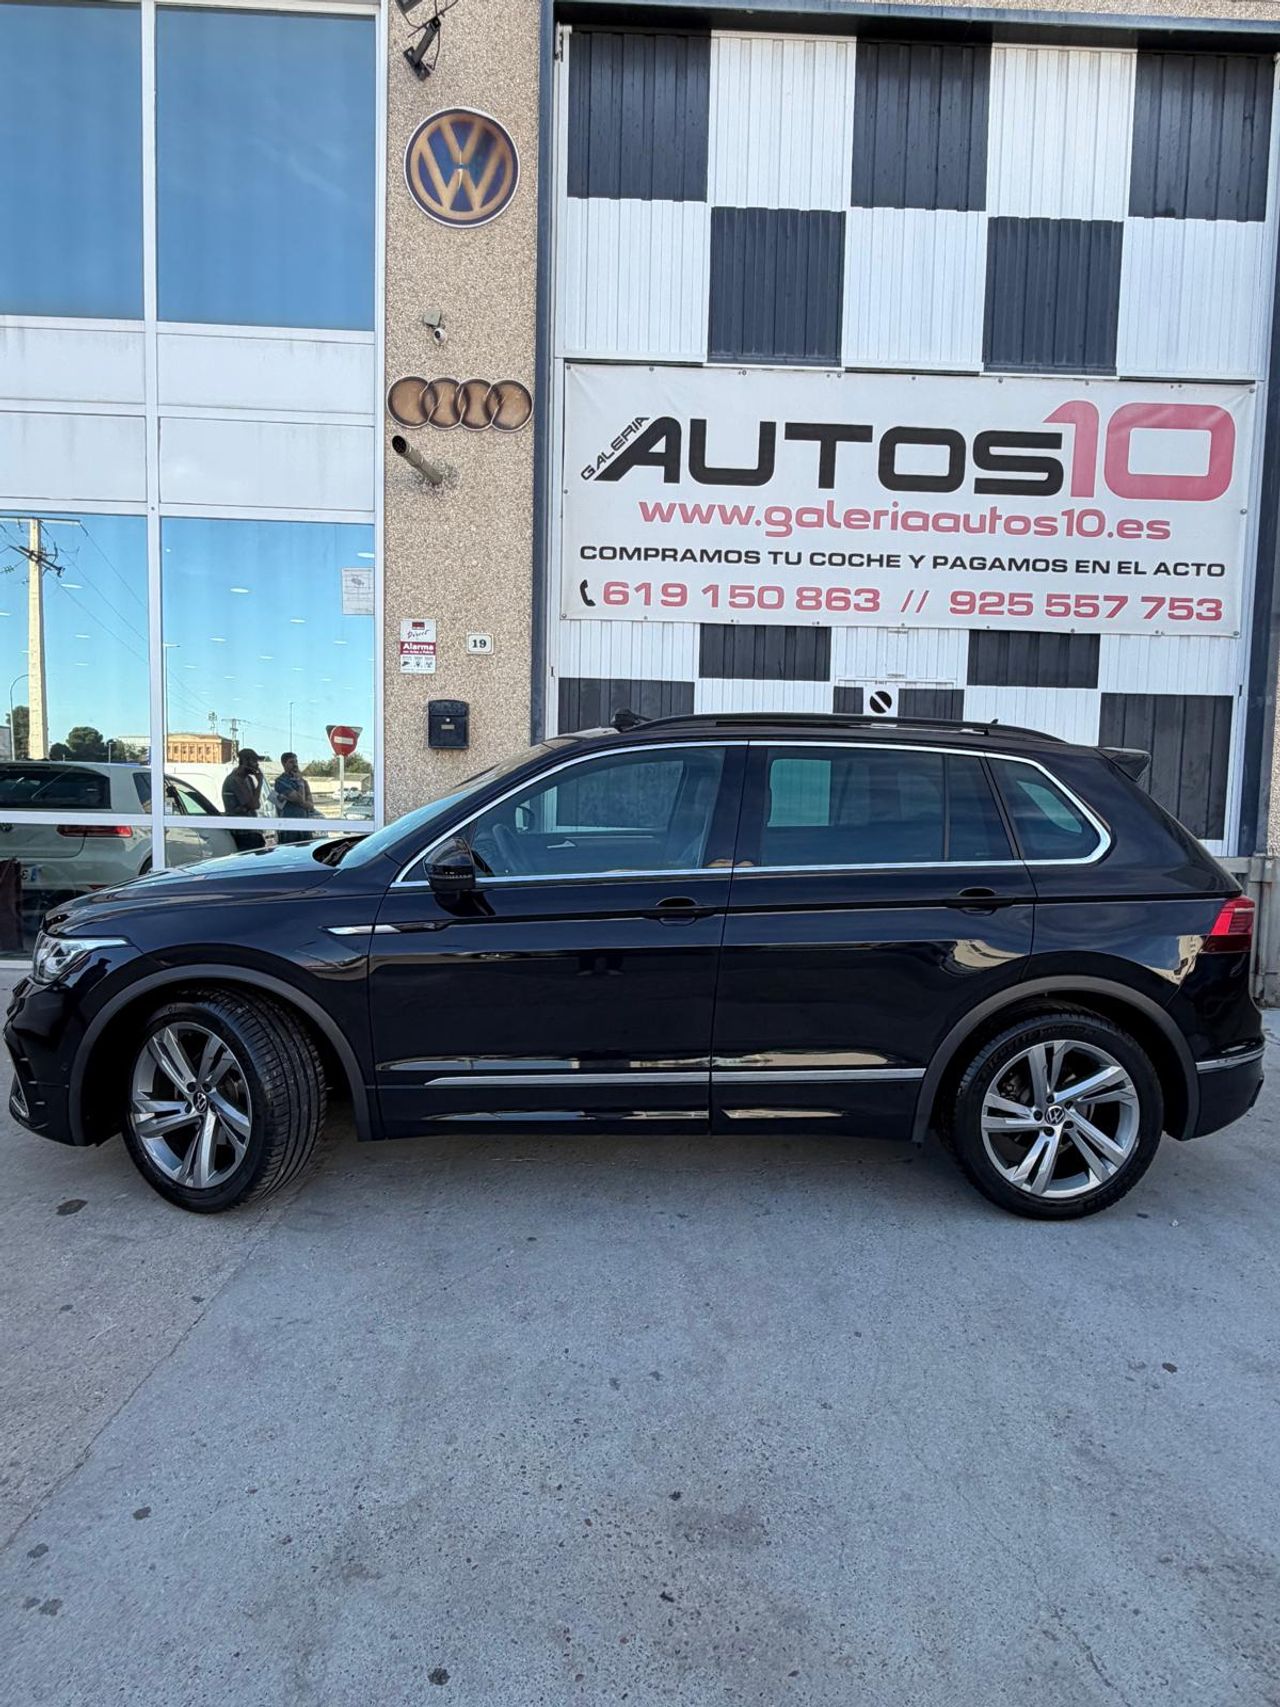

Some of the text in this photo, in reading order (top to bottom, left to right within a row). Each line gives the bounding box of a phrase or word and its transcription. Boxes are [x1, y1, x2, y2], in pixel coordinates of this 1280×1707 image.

[580, 416, 650, 481] GALERIA
[638, 500, 1171, 540] www.galeriaautos10.es
[580, 545, 1226, 577] COMPRAMOS TU COCHE Y PAGAMOS EN EL ACTO
[603, 581, 688, 607] 619
[701, 584, 785, 610] 150
[795, 586, 881, 612] 863
[949, 590, 1034, 616] 925
[1045, 593, 1129, 618] 557
[1140, 596, 1223, 621] 753
[403, 642, 434, 651] Alarma
[472, 639, 487, 649] 19
